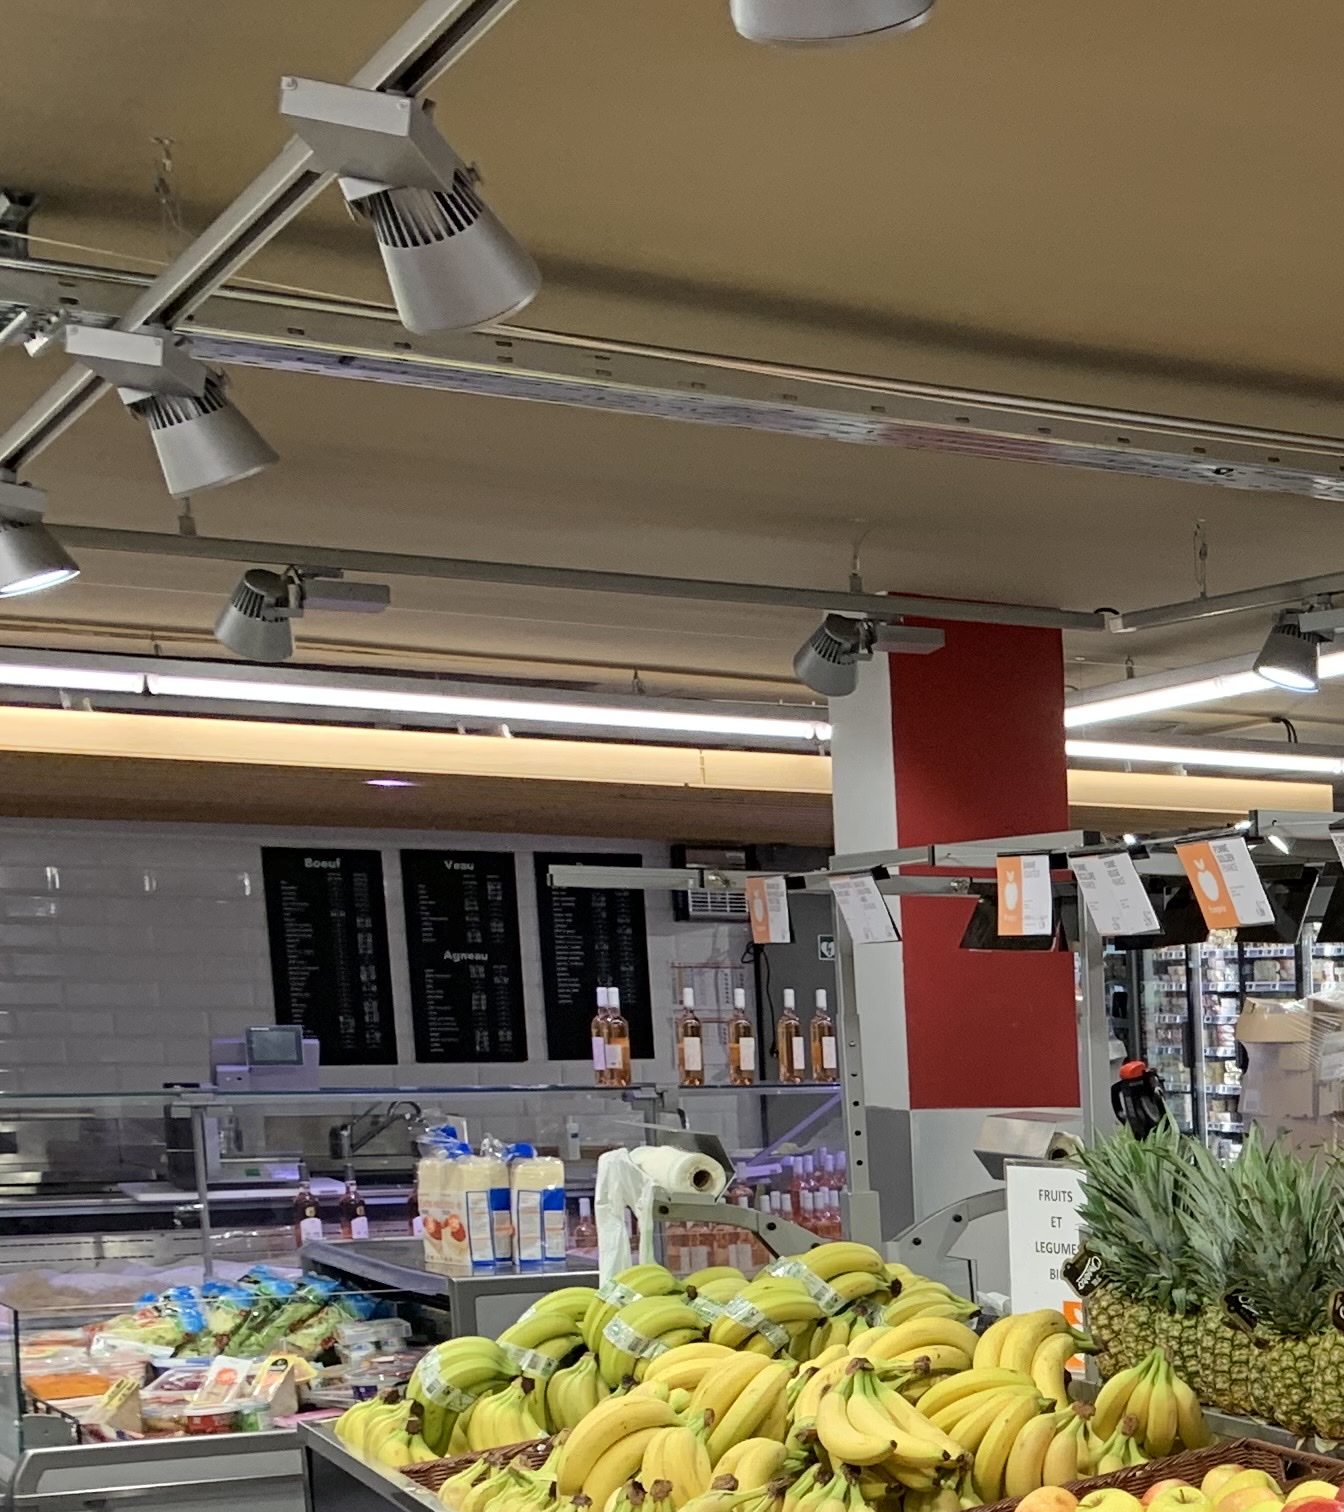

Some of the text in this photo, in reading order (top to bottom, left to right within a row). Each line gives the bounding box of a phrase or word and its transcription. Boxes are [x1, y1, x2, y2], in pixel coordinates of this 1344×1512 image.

[304, 857, 341, 869] Boeuf
[444, 860, 474, 871] Veau
[444, 950, 488, 963] Agneau
[1038, 1189, 1073, 1203] FRUITS
[1051, 1216, 1062, 1228] ET
[1050, 1268, 1059, 1280] BI
